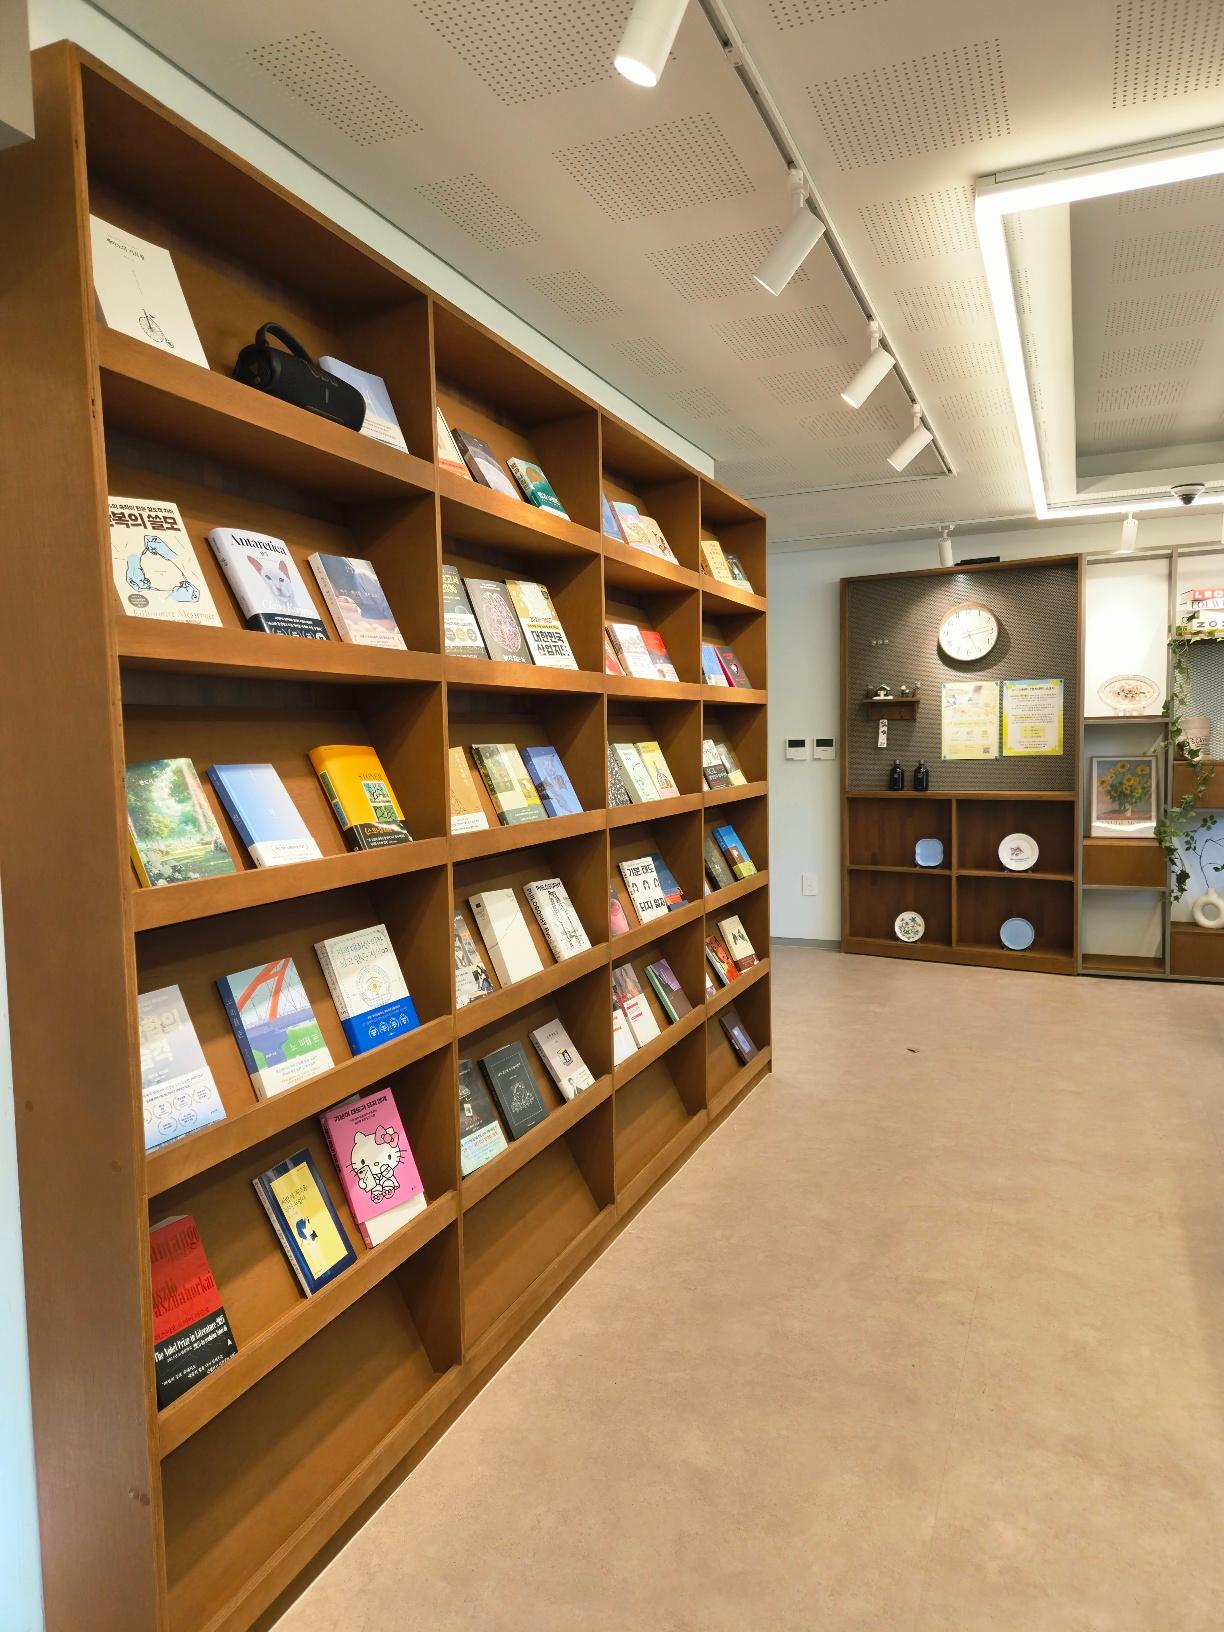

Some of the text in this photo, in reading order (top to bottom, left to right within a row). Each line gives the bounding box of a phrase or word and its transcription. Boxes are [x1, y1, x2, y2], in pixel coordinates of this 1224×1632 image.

[147, 514, 182, 532] 쓸모
[231, 534, 287, 556] Antarctica
[531, 631, 565, 644] 대한민국
[177, 1338, 190, 1350] Prize
